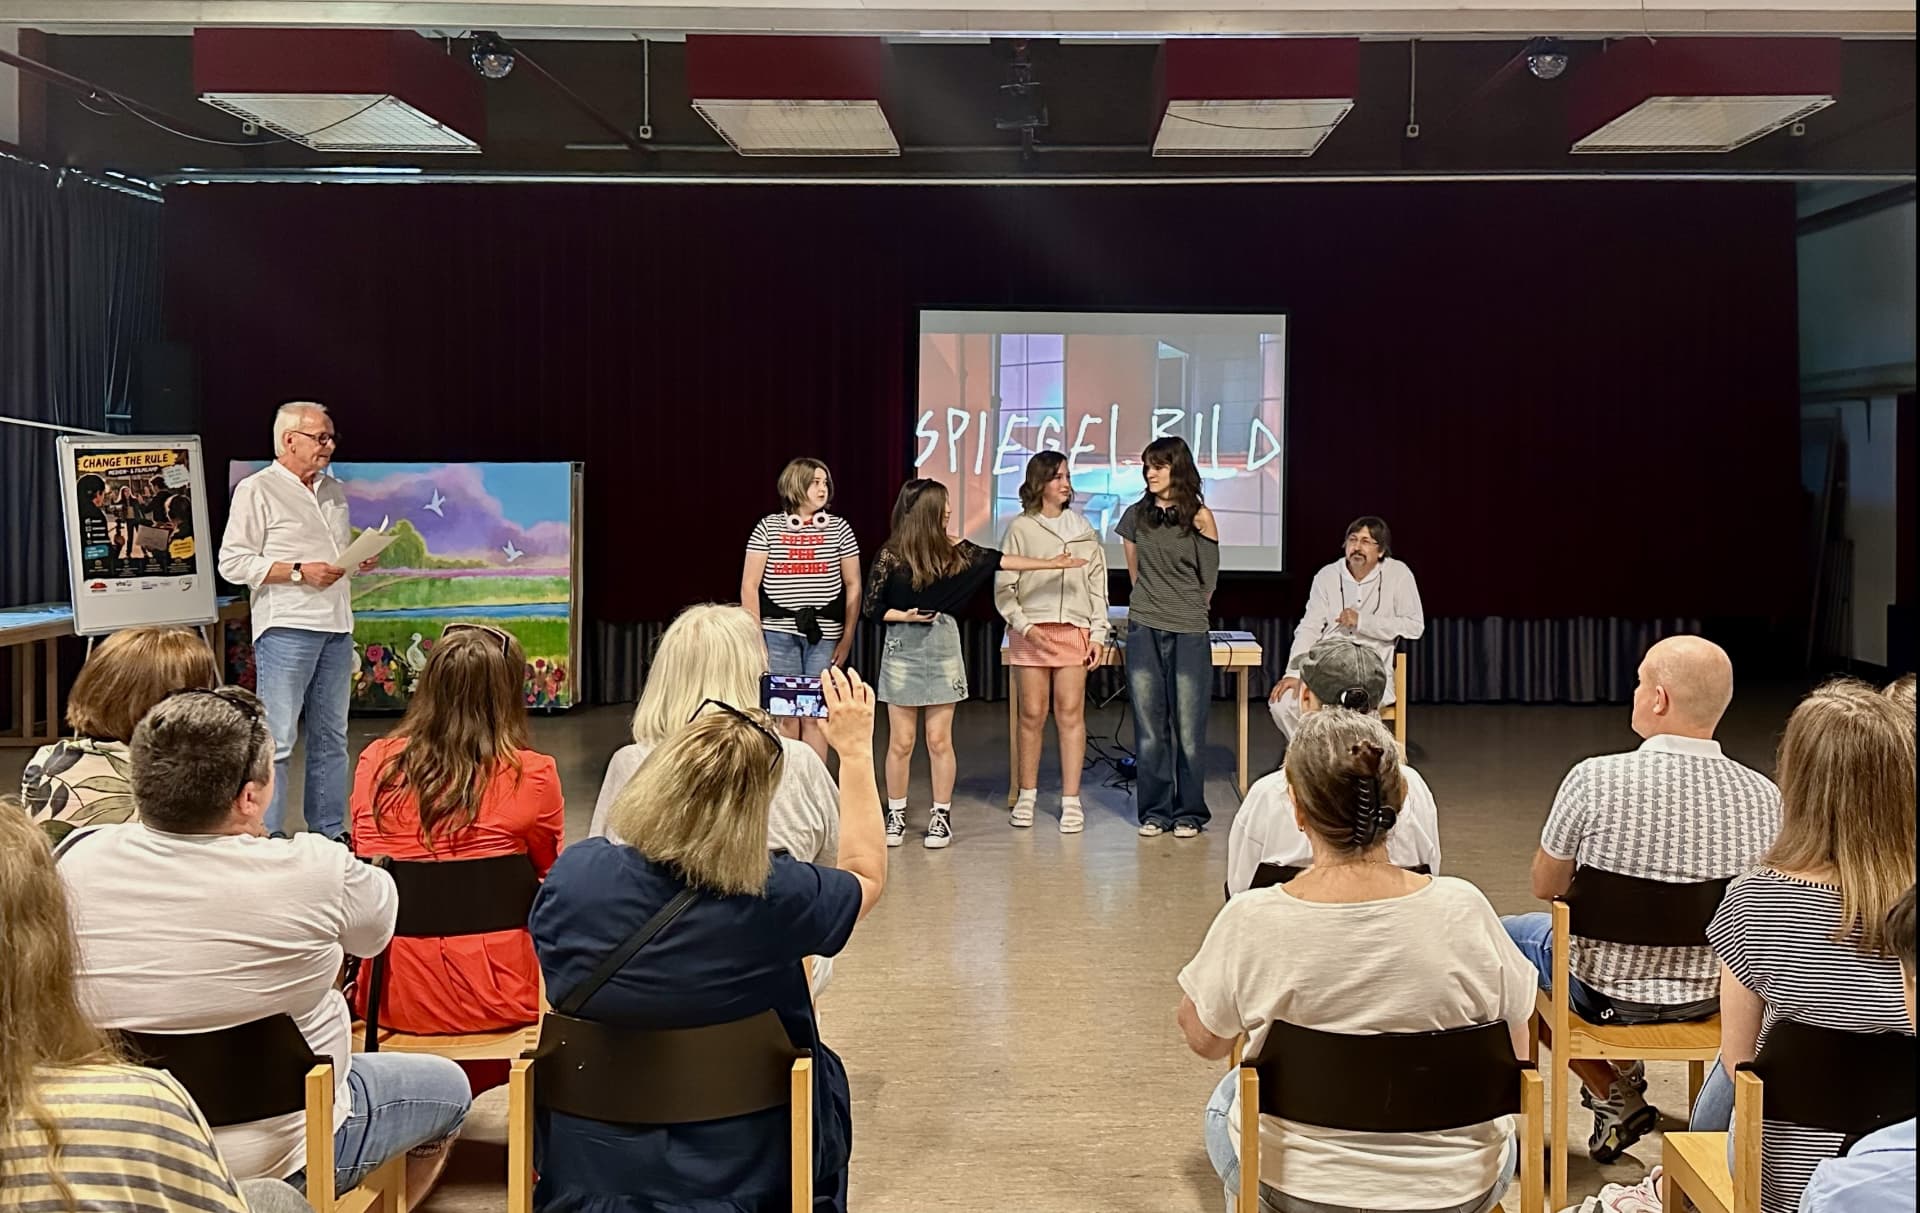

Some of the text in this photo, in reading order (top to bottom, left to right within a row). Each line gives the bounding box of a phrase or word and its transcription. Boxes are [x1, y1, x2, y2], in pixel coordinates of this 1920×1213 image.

[83, 453, 169, 469] CHANGE THE RULE
